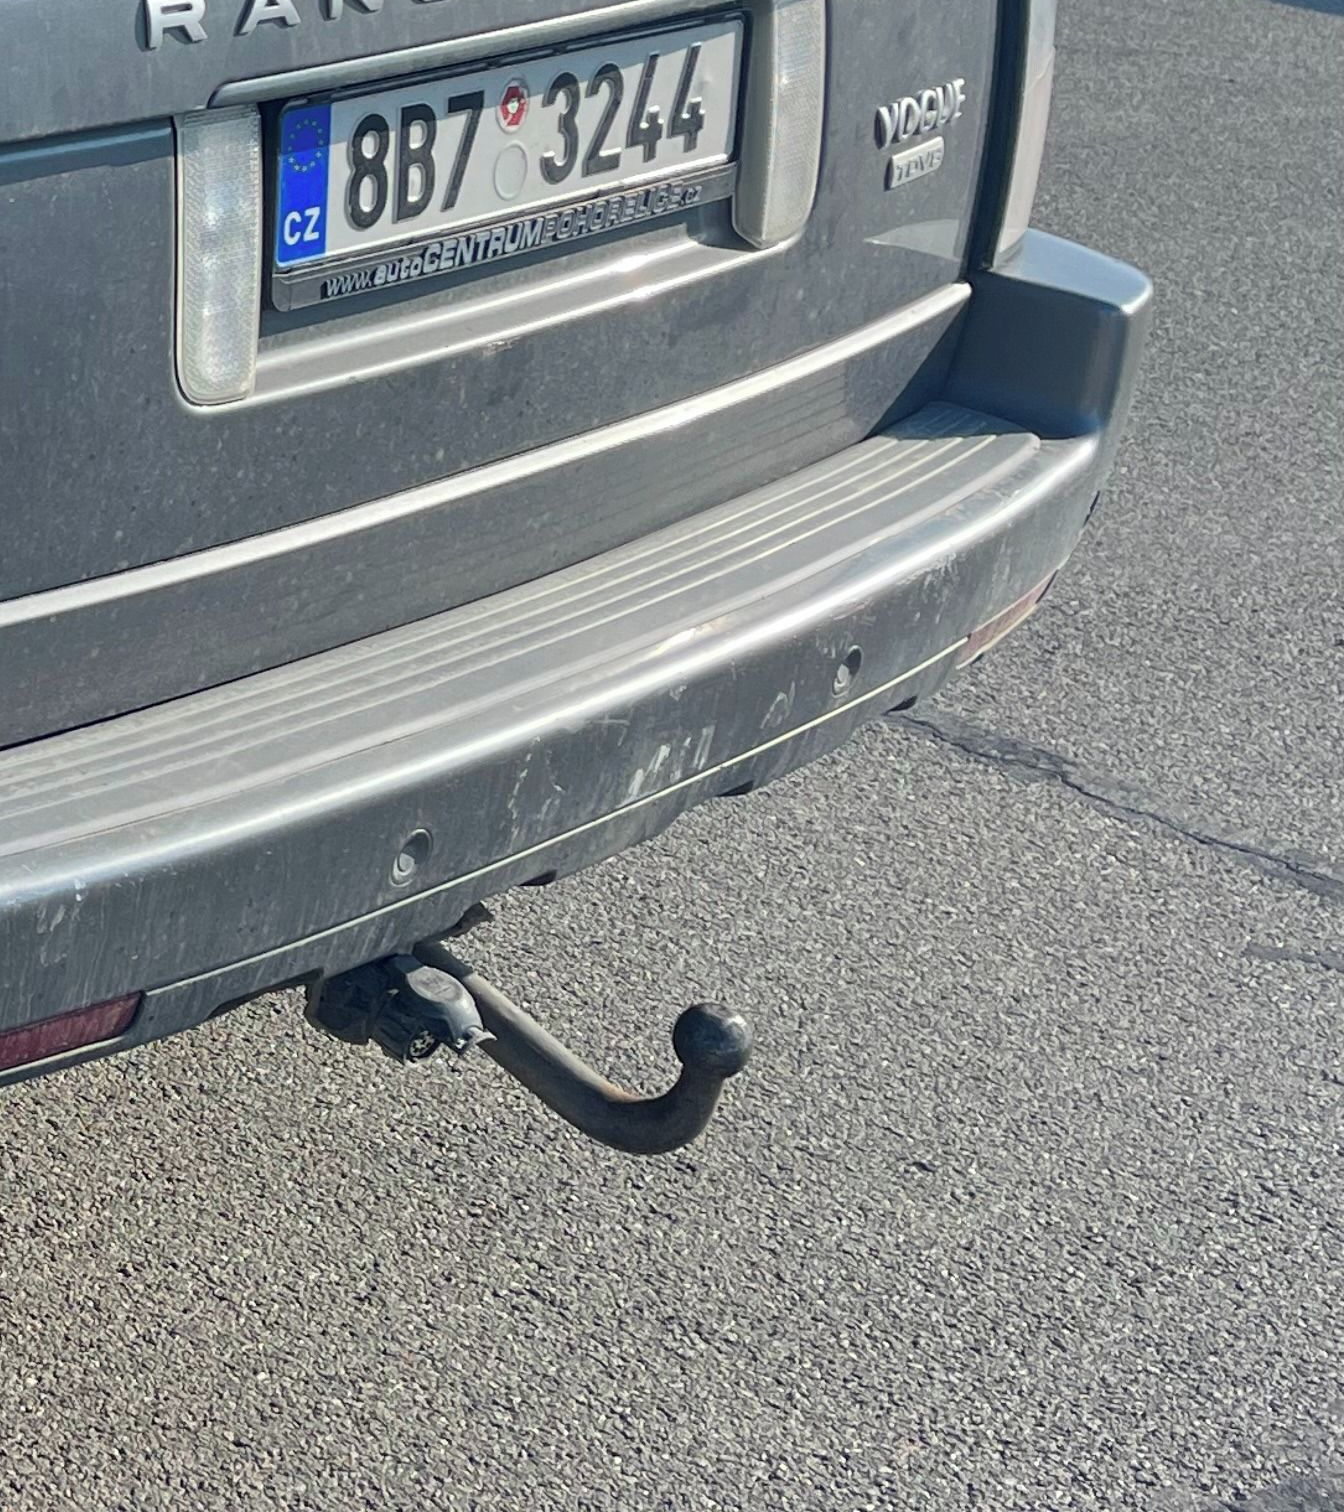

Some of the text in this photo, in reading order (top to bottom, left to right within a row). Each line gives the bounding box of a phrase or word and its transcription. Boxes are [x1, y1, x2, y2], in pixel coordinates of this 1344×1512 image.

[345, 41, 707, 232] 8B7 3244
[875, 77, 967, 149] VOGUE
[282, 206, 320, 246] CZ
